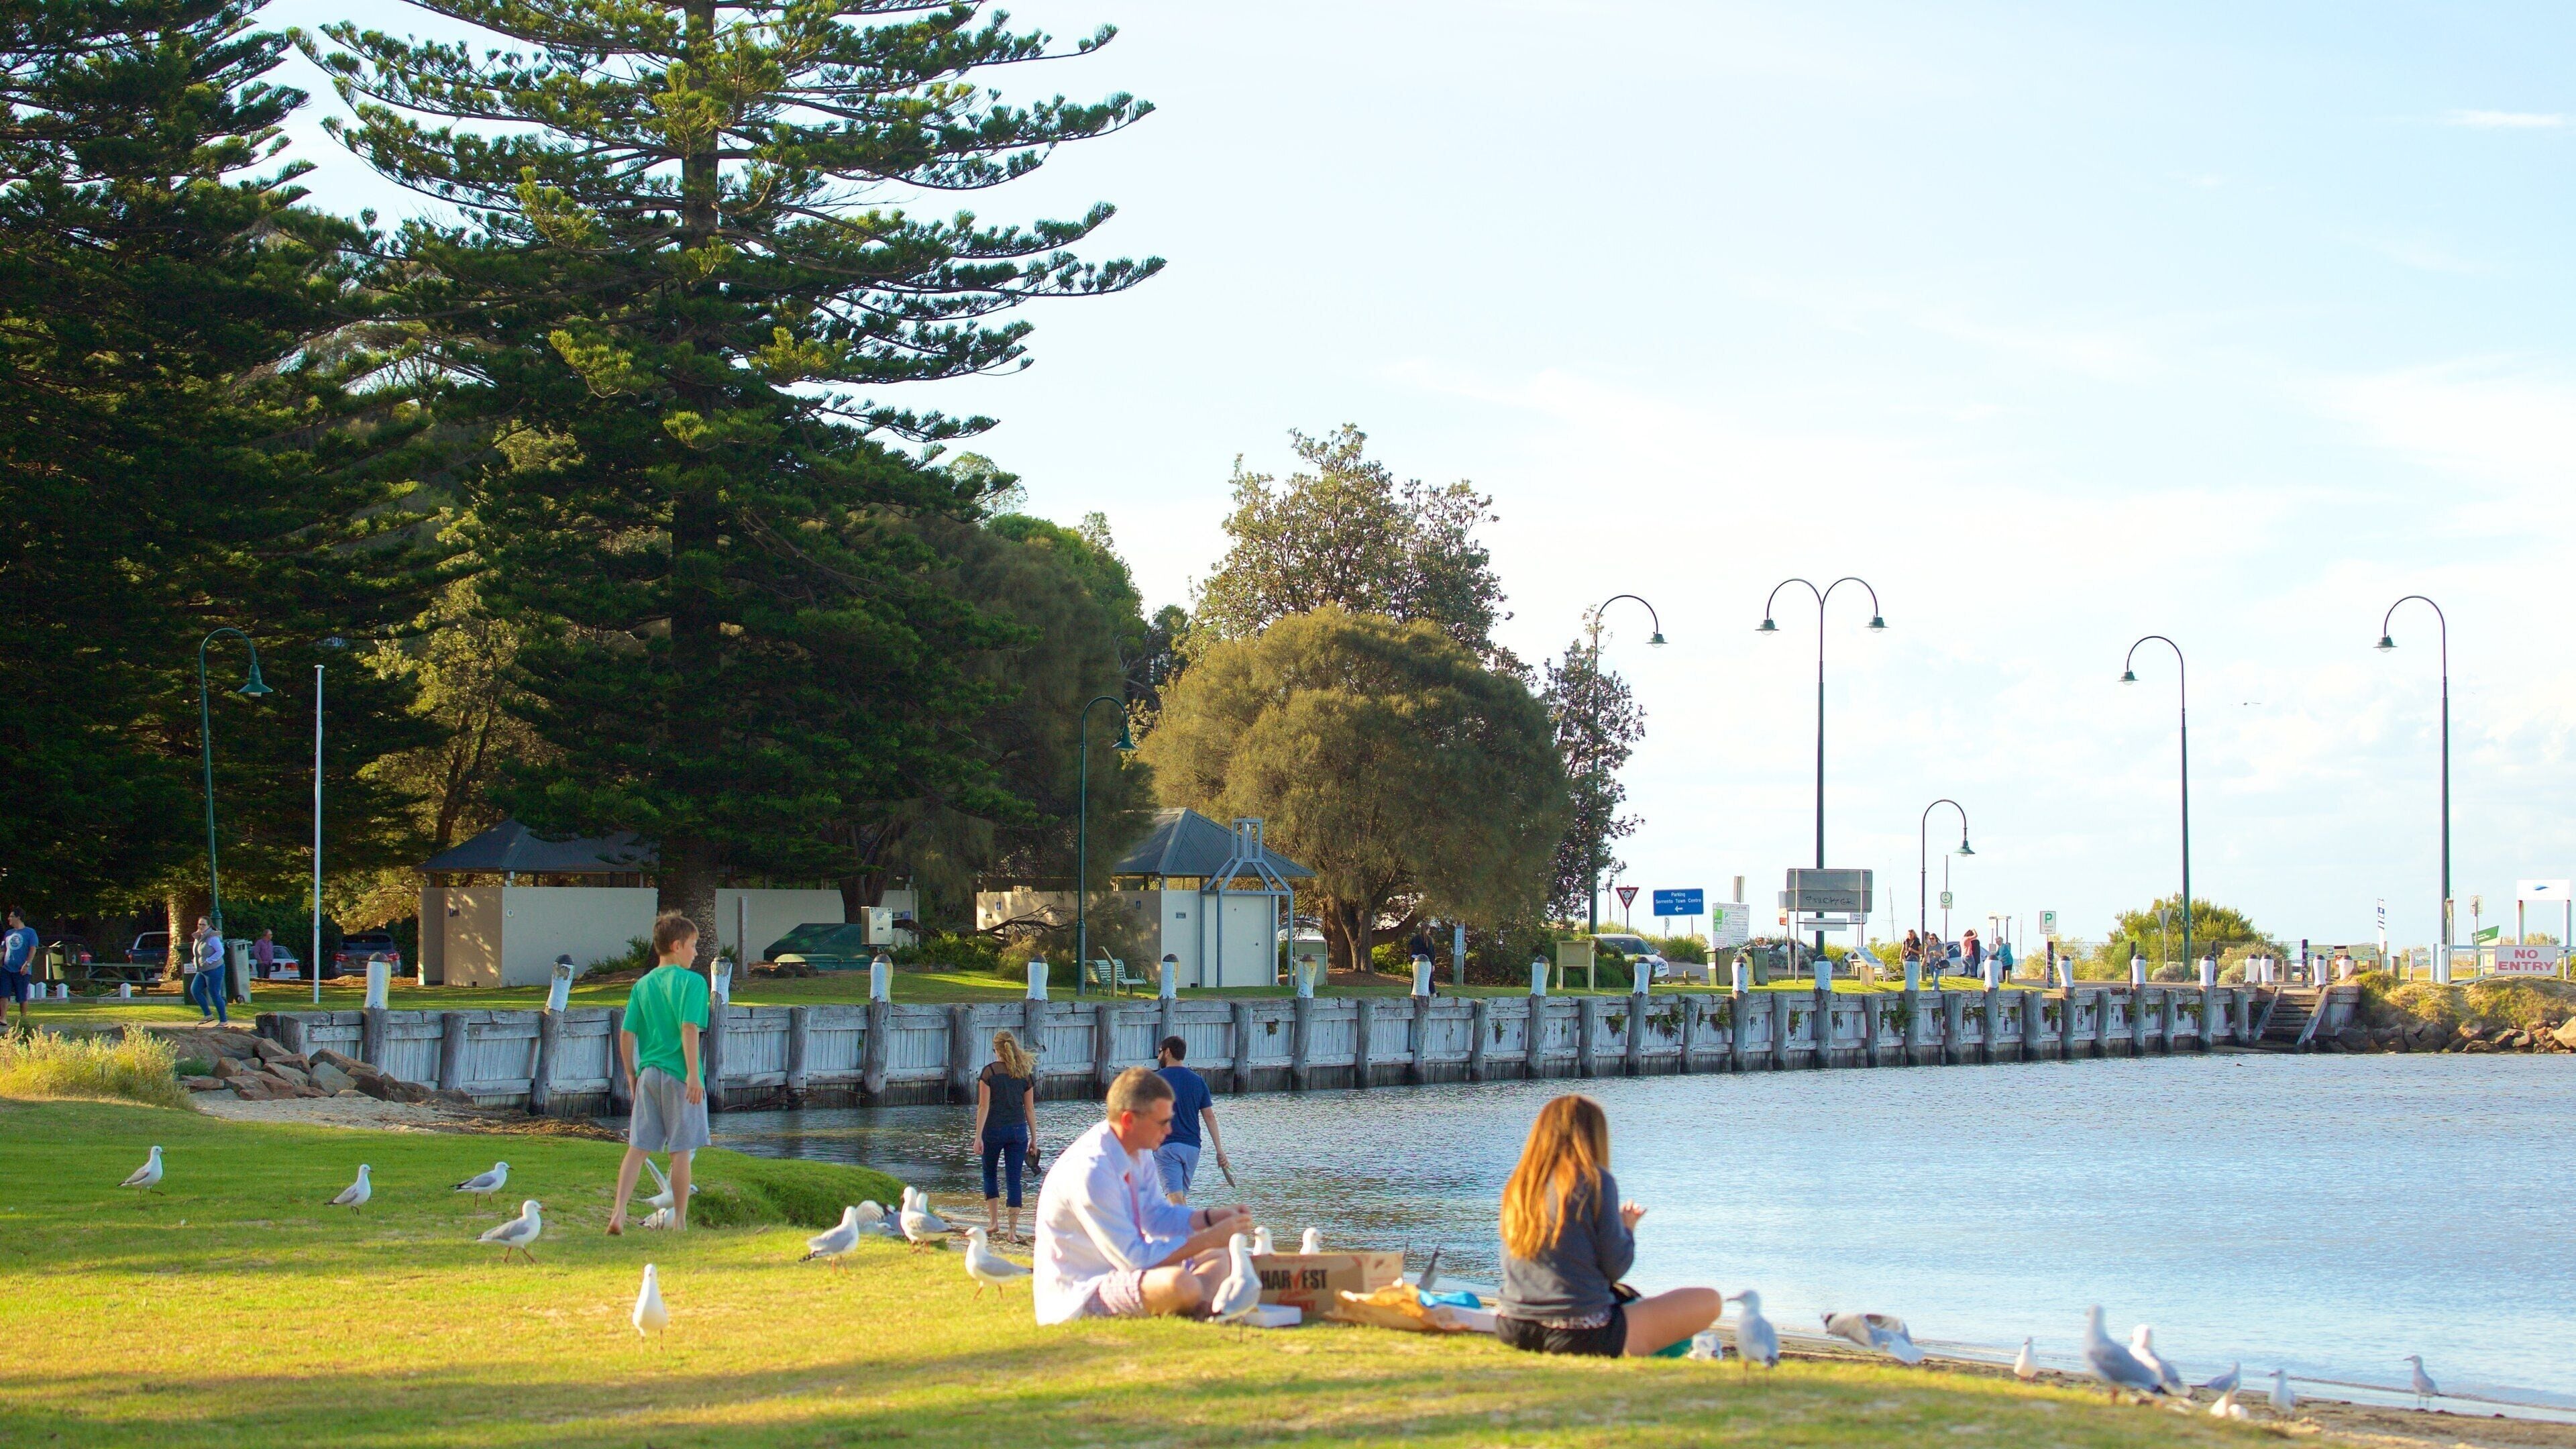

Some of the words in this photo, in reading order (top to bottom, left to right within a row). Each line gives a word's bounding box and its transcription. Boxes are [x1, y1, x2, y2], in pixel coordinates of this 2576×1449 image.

[2045, 913, 2053, 924] P
[2514, 949, 2538, 959] NO
[2498, 961, 2555, 971] ENTRY
